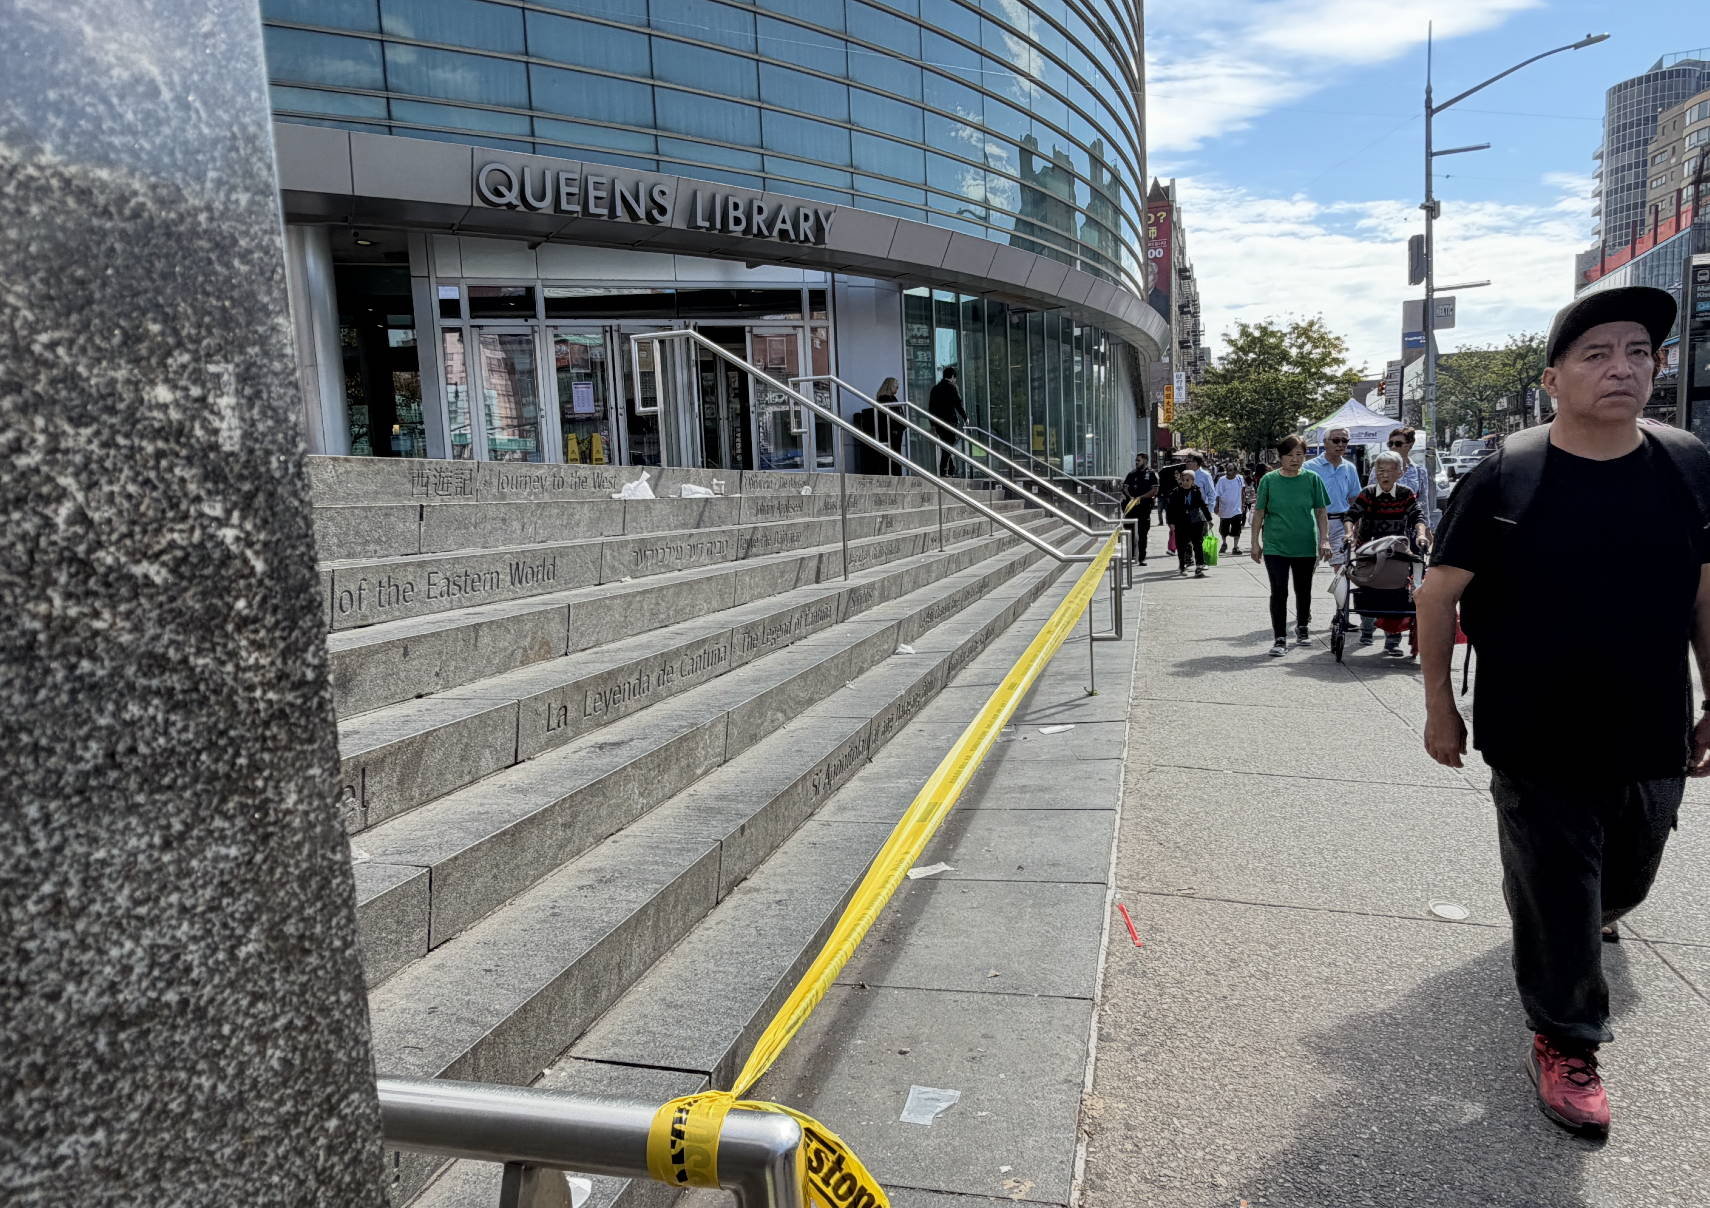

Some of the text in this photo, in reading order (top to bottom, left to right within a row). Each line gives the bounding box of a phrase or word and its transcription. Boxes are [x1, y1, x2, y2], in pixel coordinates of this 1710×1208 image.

[477, 162, 836, 244] QUEENS LIBRARY
[408, 467, 473, 498] 西遊記
[497, 469, 618, 493] Journey to the West
[339, 555, 556, 614] of the Eastern World
[742, 604, 832, 653] The Legend of Cantuña
[546, 642, 727, 733] La Leyenda de Cantuña
[812, 768, 821, 797] Si
